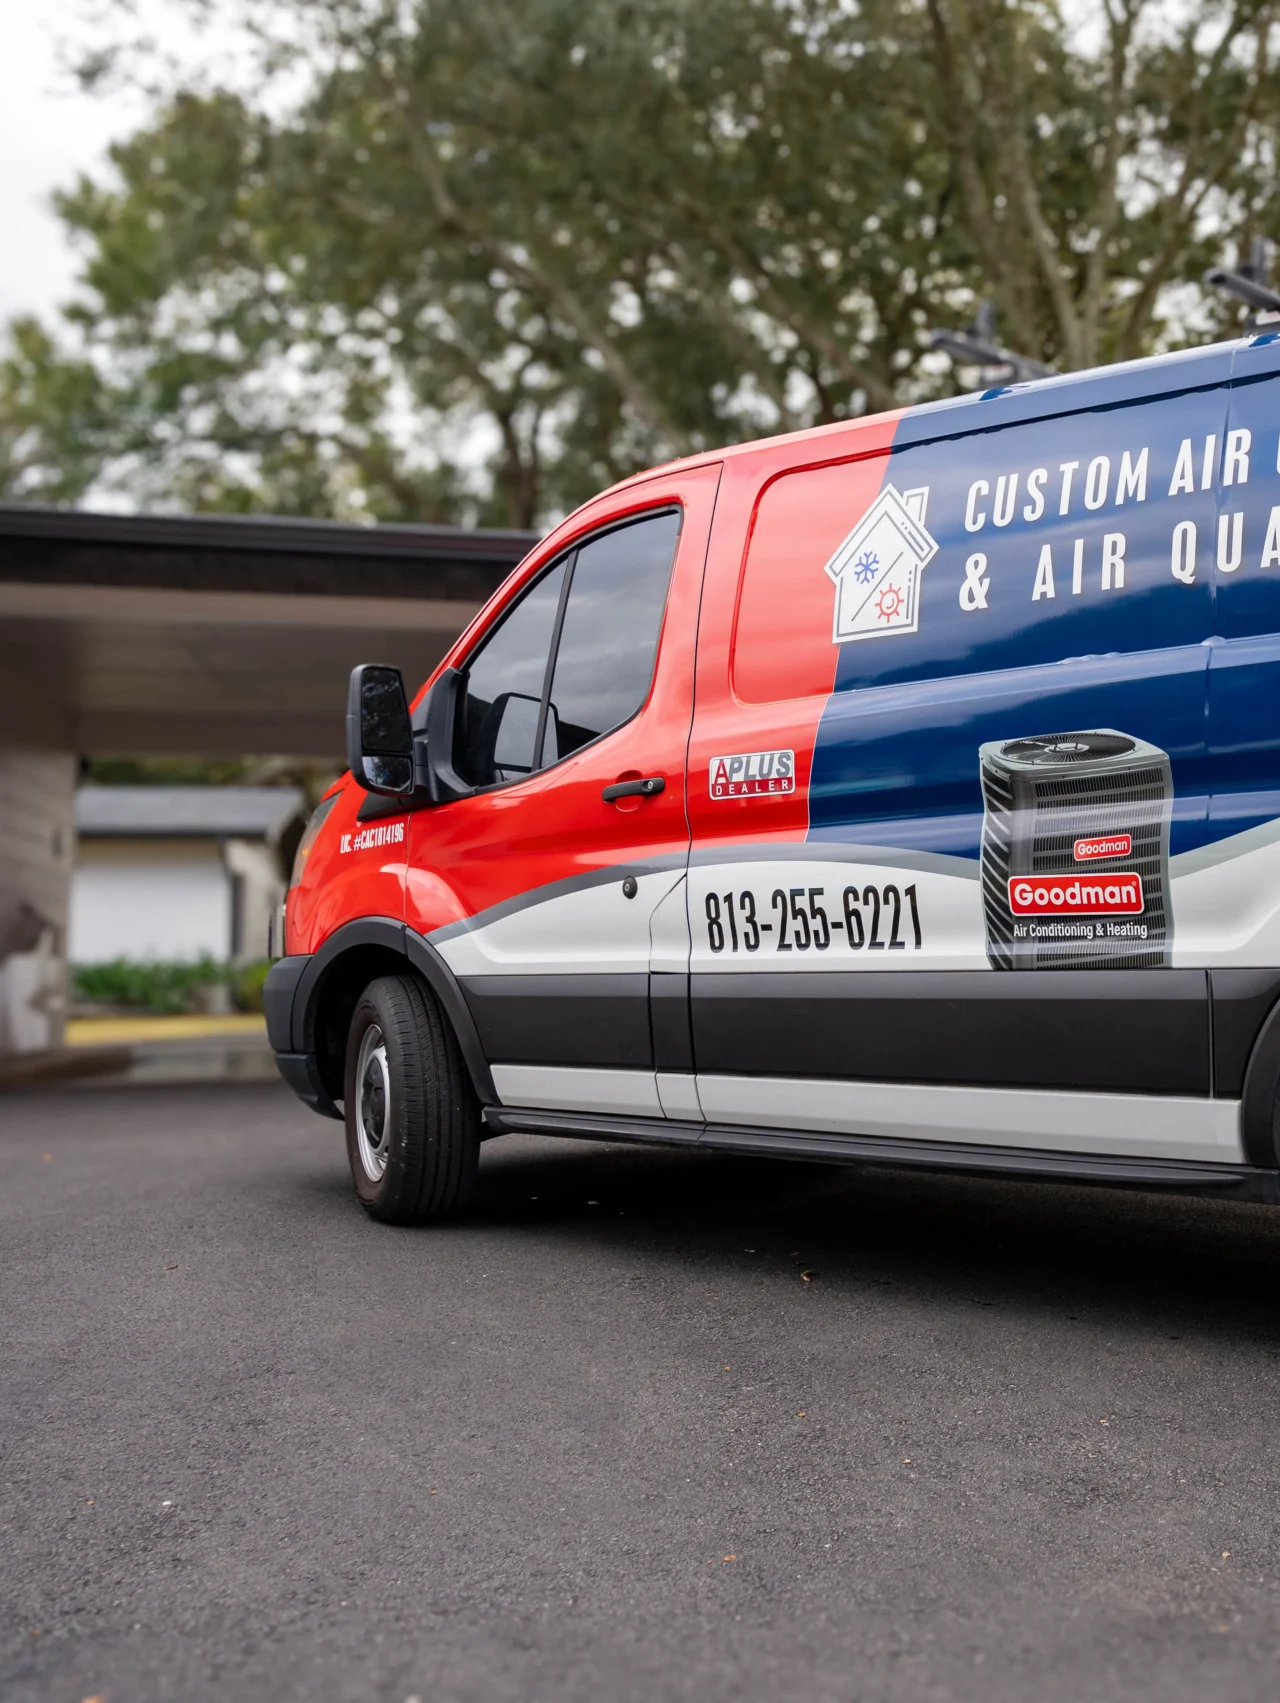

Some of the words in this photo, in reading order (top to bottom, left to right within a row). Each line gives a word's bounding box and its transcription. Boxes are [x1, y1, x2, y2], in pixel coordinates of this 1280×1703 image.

[963, 447, 1149, 533] CUSTOM
[1169, 428, 1253, 497] AIR
[958, 552, 991, 612] &
[1031, 532, 1127, 602] AIR
[715, 779, 789, 796] DEALER
[340, 834, 352, 855] LIC.
[1077, 838, 1129, 856] Goodman
[705, 883, 923, 954] 813-255-6221
[1013, 923, 1028, 938] Air
[1029, 923, 1095, 940] Conditioning
[1096, 923, 1105, 937] &
[1106, 921, 1149, 939] Heating
